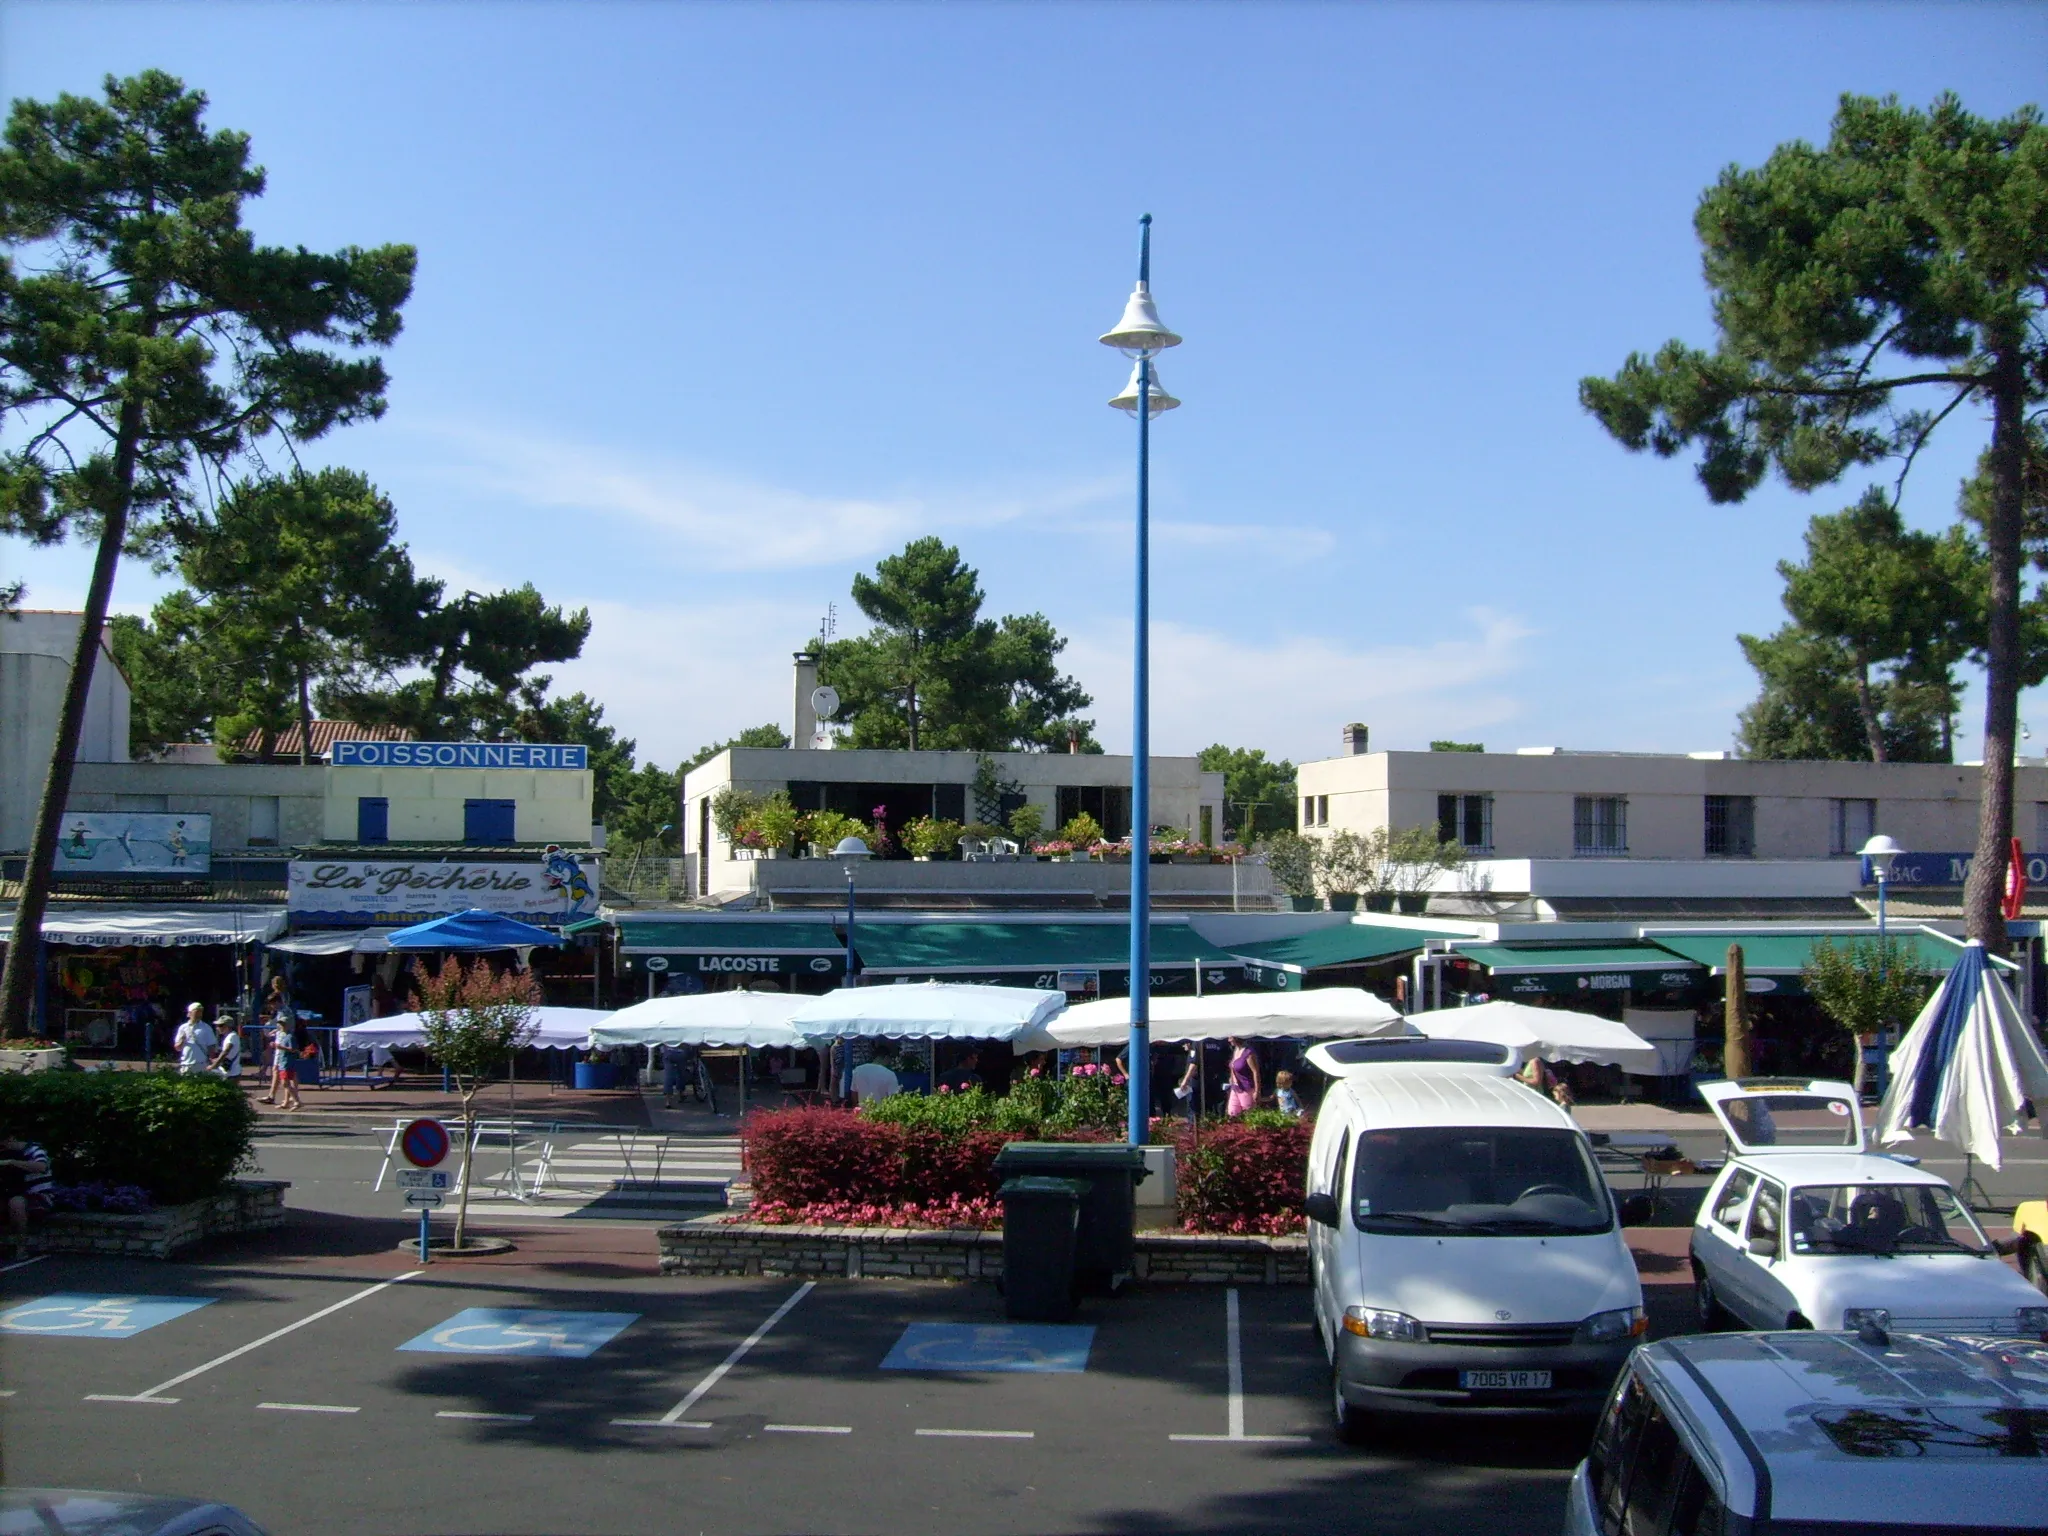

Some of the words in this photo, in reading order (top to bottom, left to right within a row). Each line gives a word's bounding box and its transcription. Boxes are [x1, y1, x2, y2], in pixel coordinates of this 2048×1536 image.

[339, 744, 579, 767] POISSONNERIE
[306, 864, 366, 889] La
[75, 935, 122, 945] CADEAUX
[699, 956, 780, 972] LACOSTE
[1590, 974, 1631, 989] MORGAN
[1470, 1372, 1507, 1387] 7005
[1511, 1372, 1528, 1387] VR
[1532, 1372, 1549, 1387] 17
